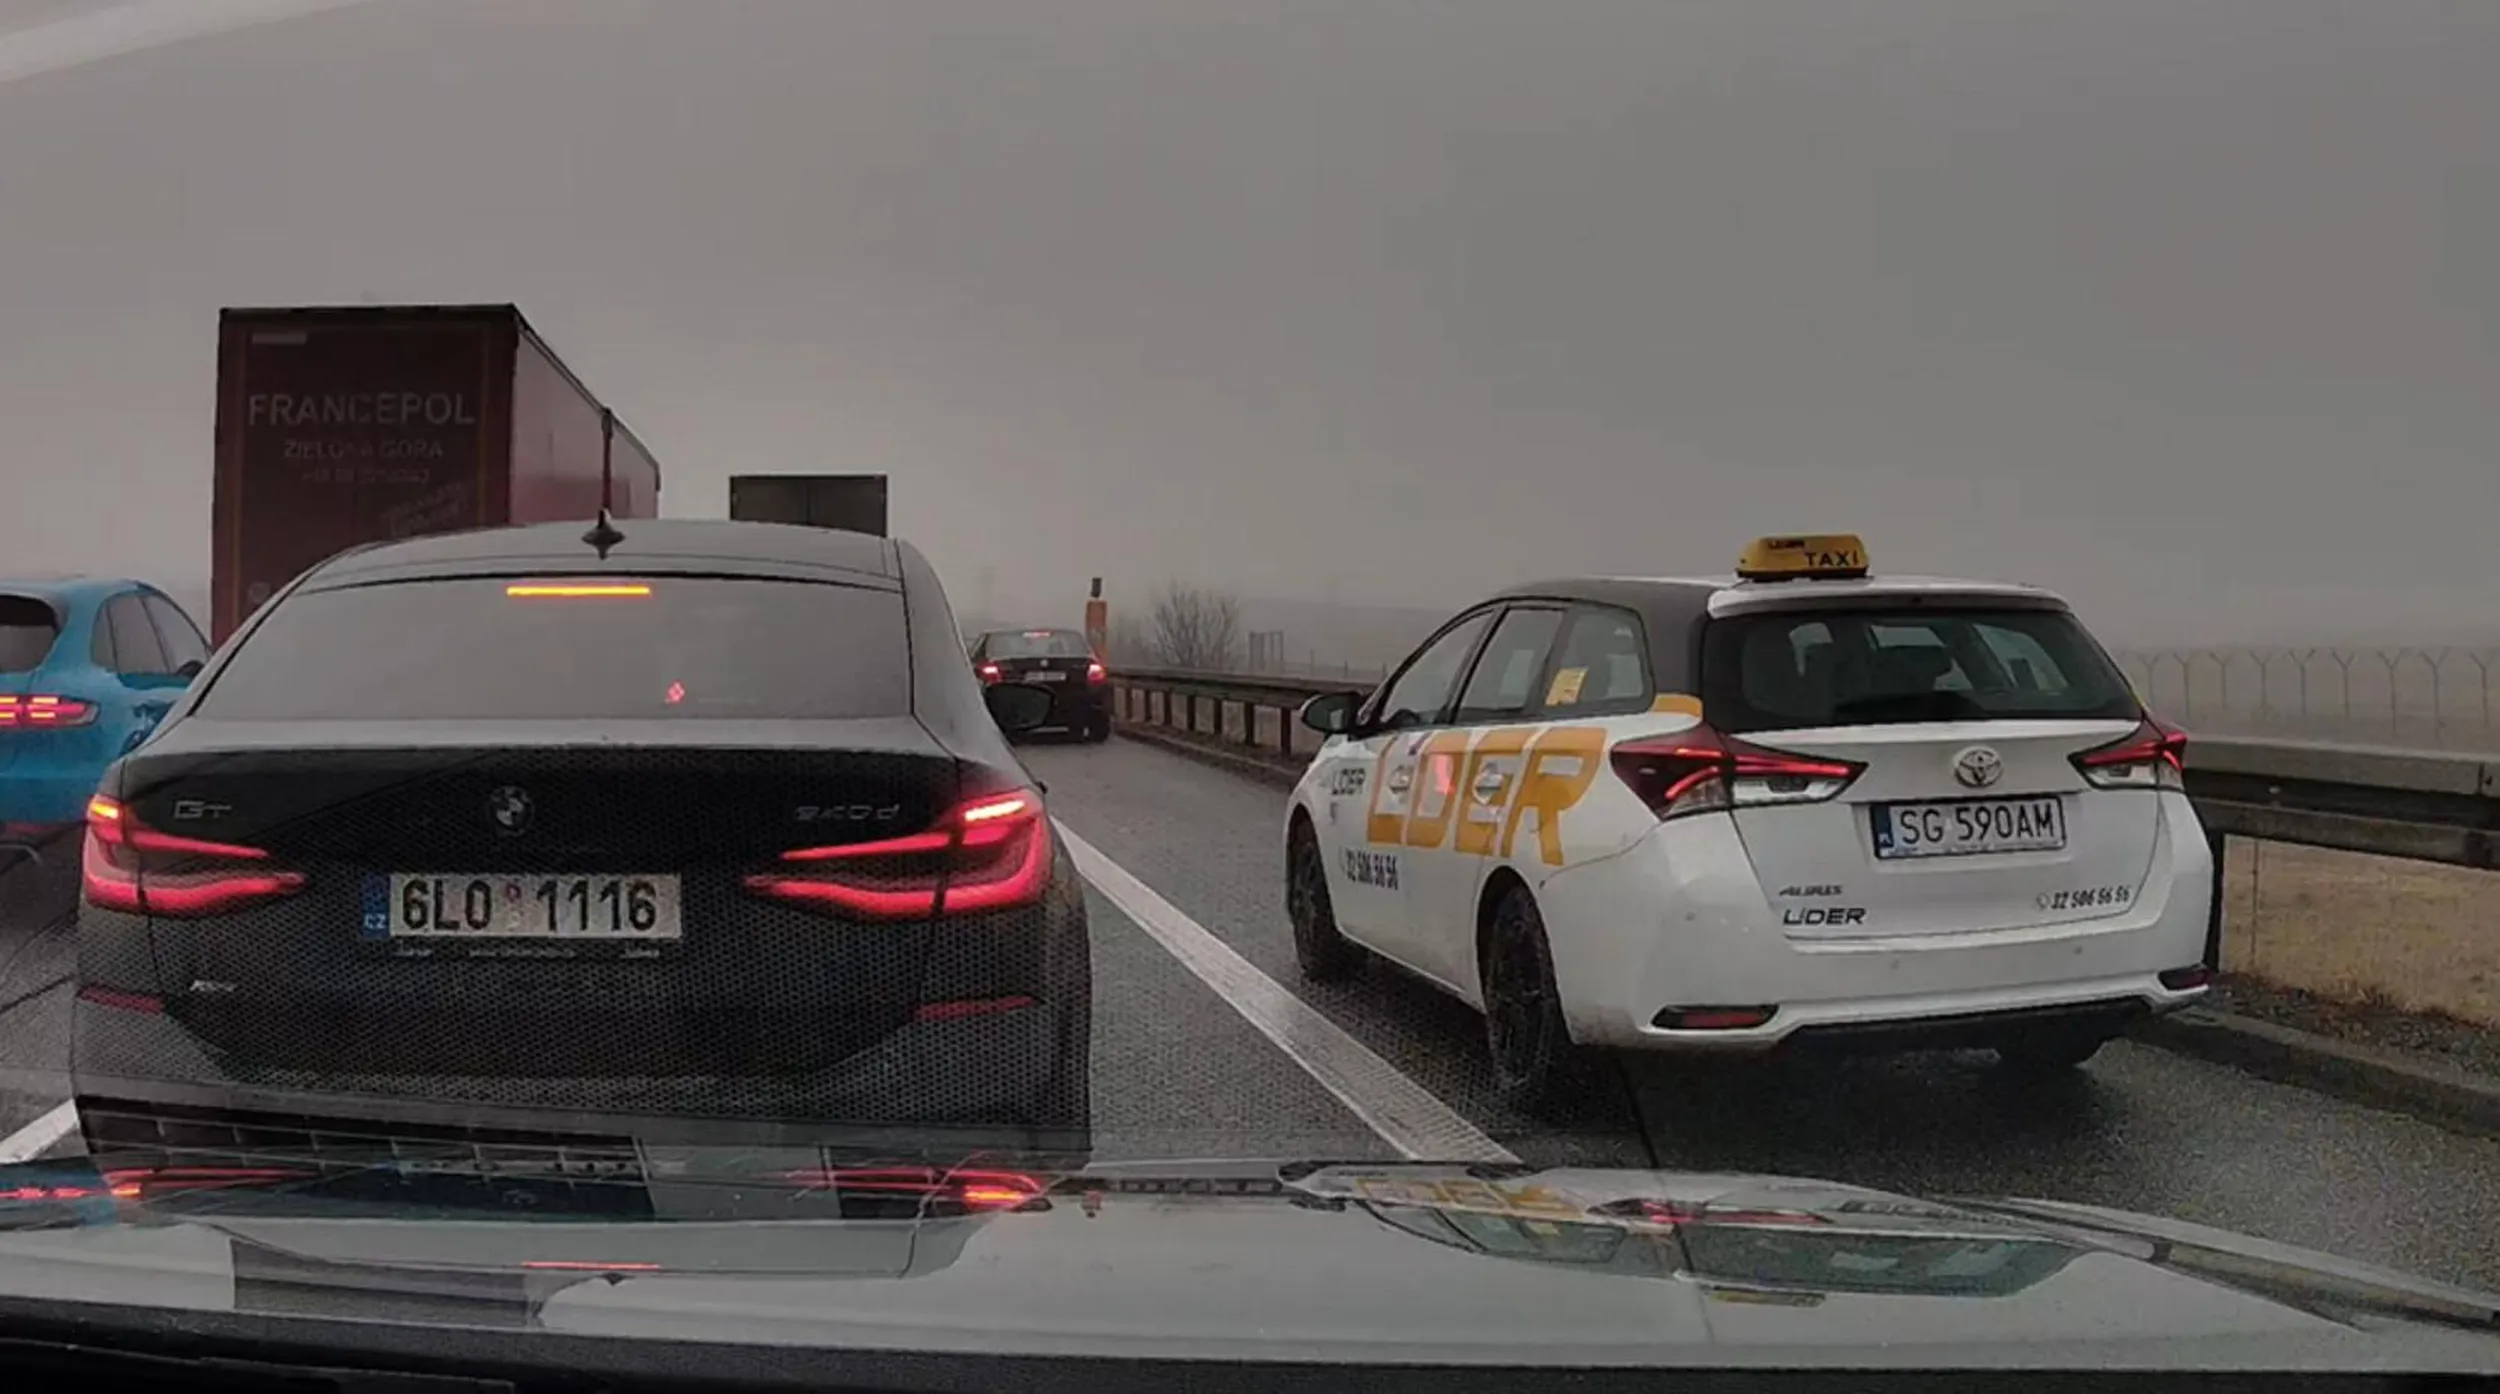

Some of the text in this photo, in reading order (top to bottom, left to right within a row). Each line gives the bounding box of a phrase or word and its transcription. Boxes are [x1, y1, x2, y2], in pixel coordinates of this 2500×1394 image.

[248, 392, 477, 426] FRANCEPOL
[1804, 549, 1858, 566] TAXI
[174, 801, 232, 818] GT
[1900, 803, 2055, 844] SG 590AM
[536, 879, 657, 931] 1116
[364, 913, 386, 930] CZ
